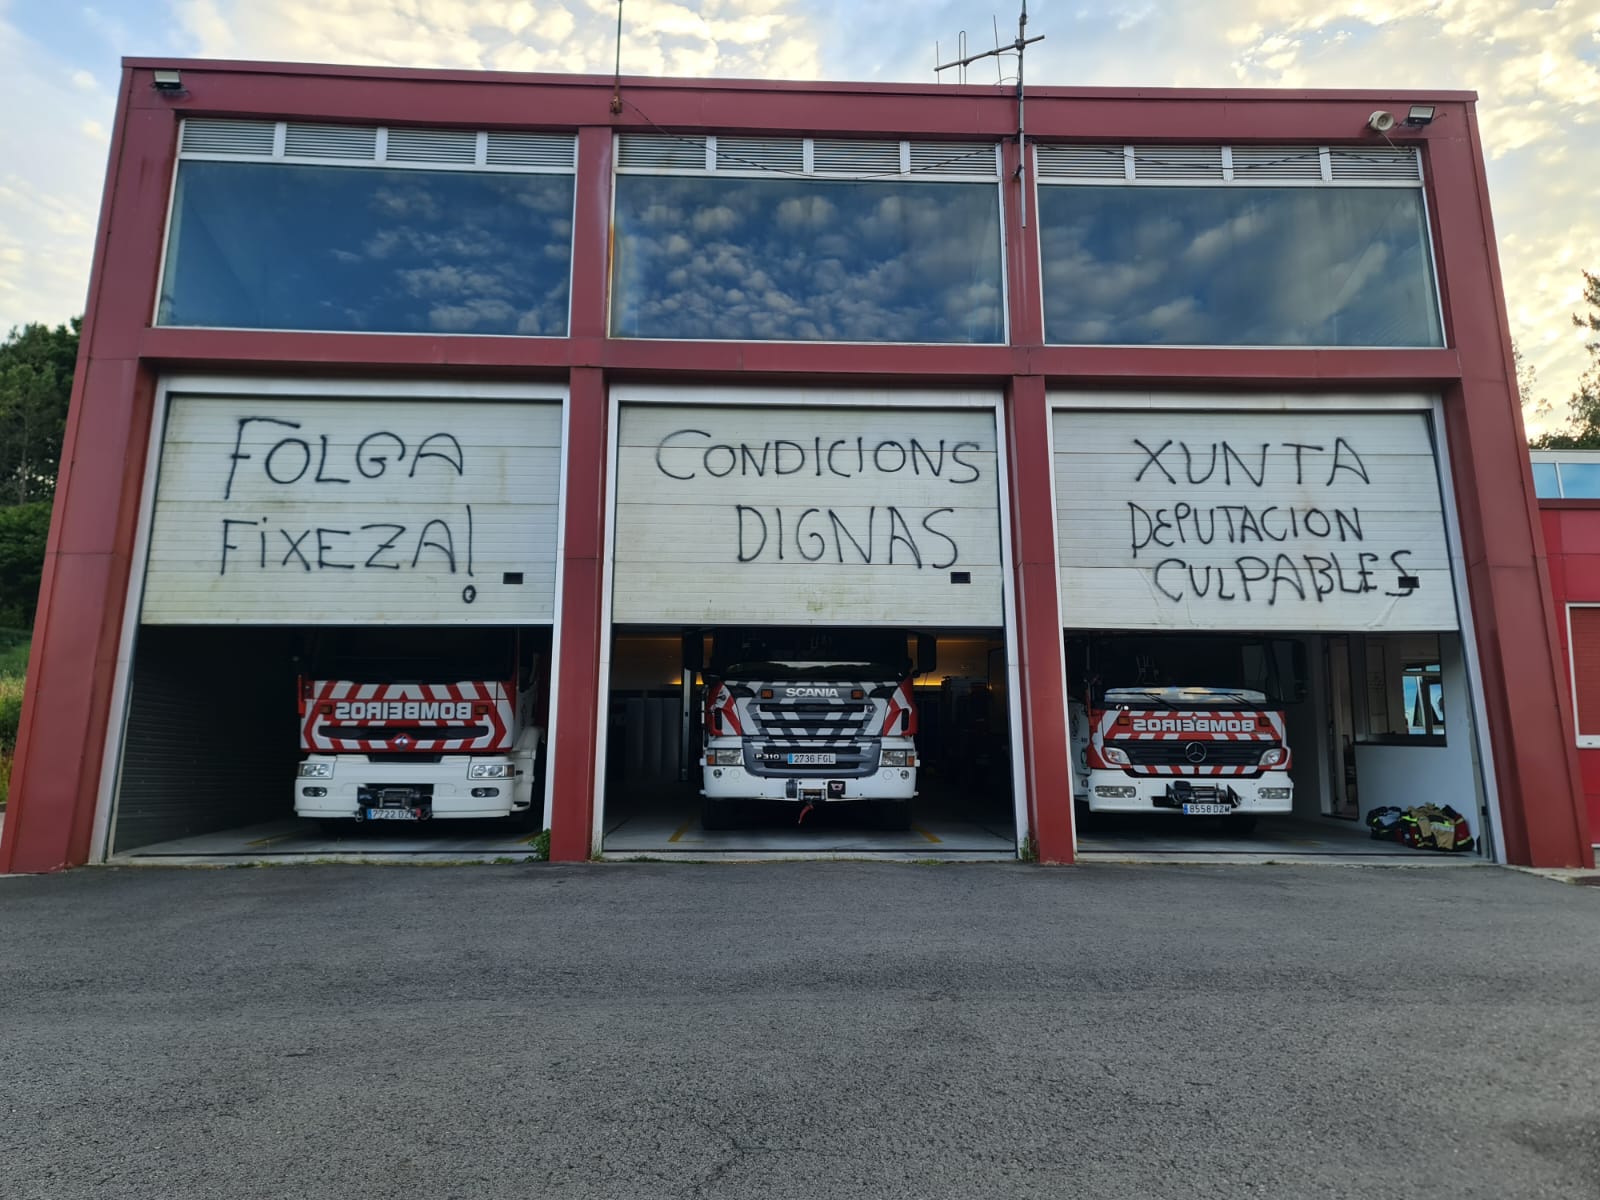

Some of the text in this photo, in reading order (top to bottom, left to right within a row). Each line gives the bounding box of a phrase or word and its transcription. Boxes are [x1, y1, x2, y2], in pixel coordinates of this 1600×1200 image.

[224, 417, 464, 500] FOLGA
[656, 429, 981, 484] CONDICIONS
[1132, 436, 1370, 487] XUNTA
[736, 504, 958, 569] DIGNAS
[1127, 501, 1364, 559] DEPUTACION
[1154, 550, 1414, 605] CULPABLES
[785, 687, 839, 698] SCANIA
[372, 809, 396, 819] 7722
